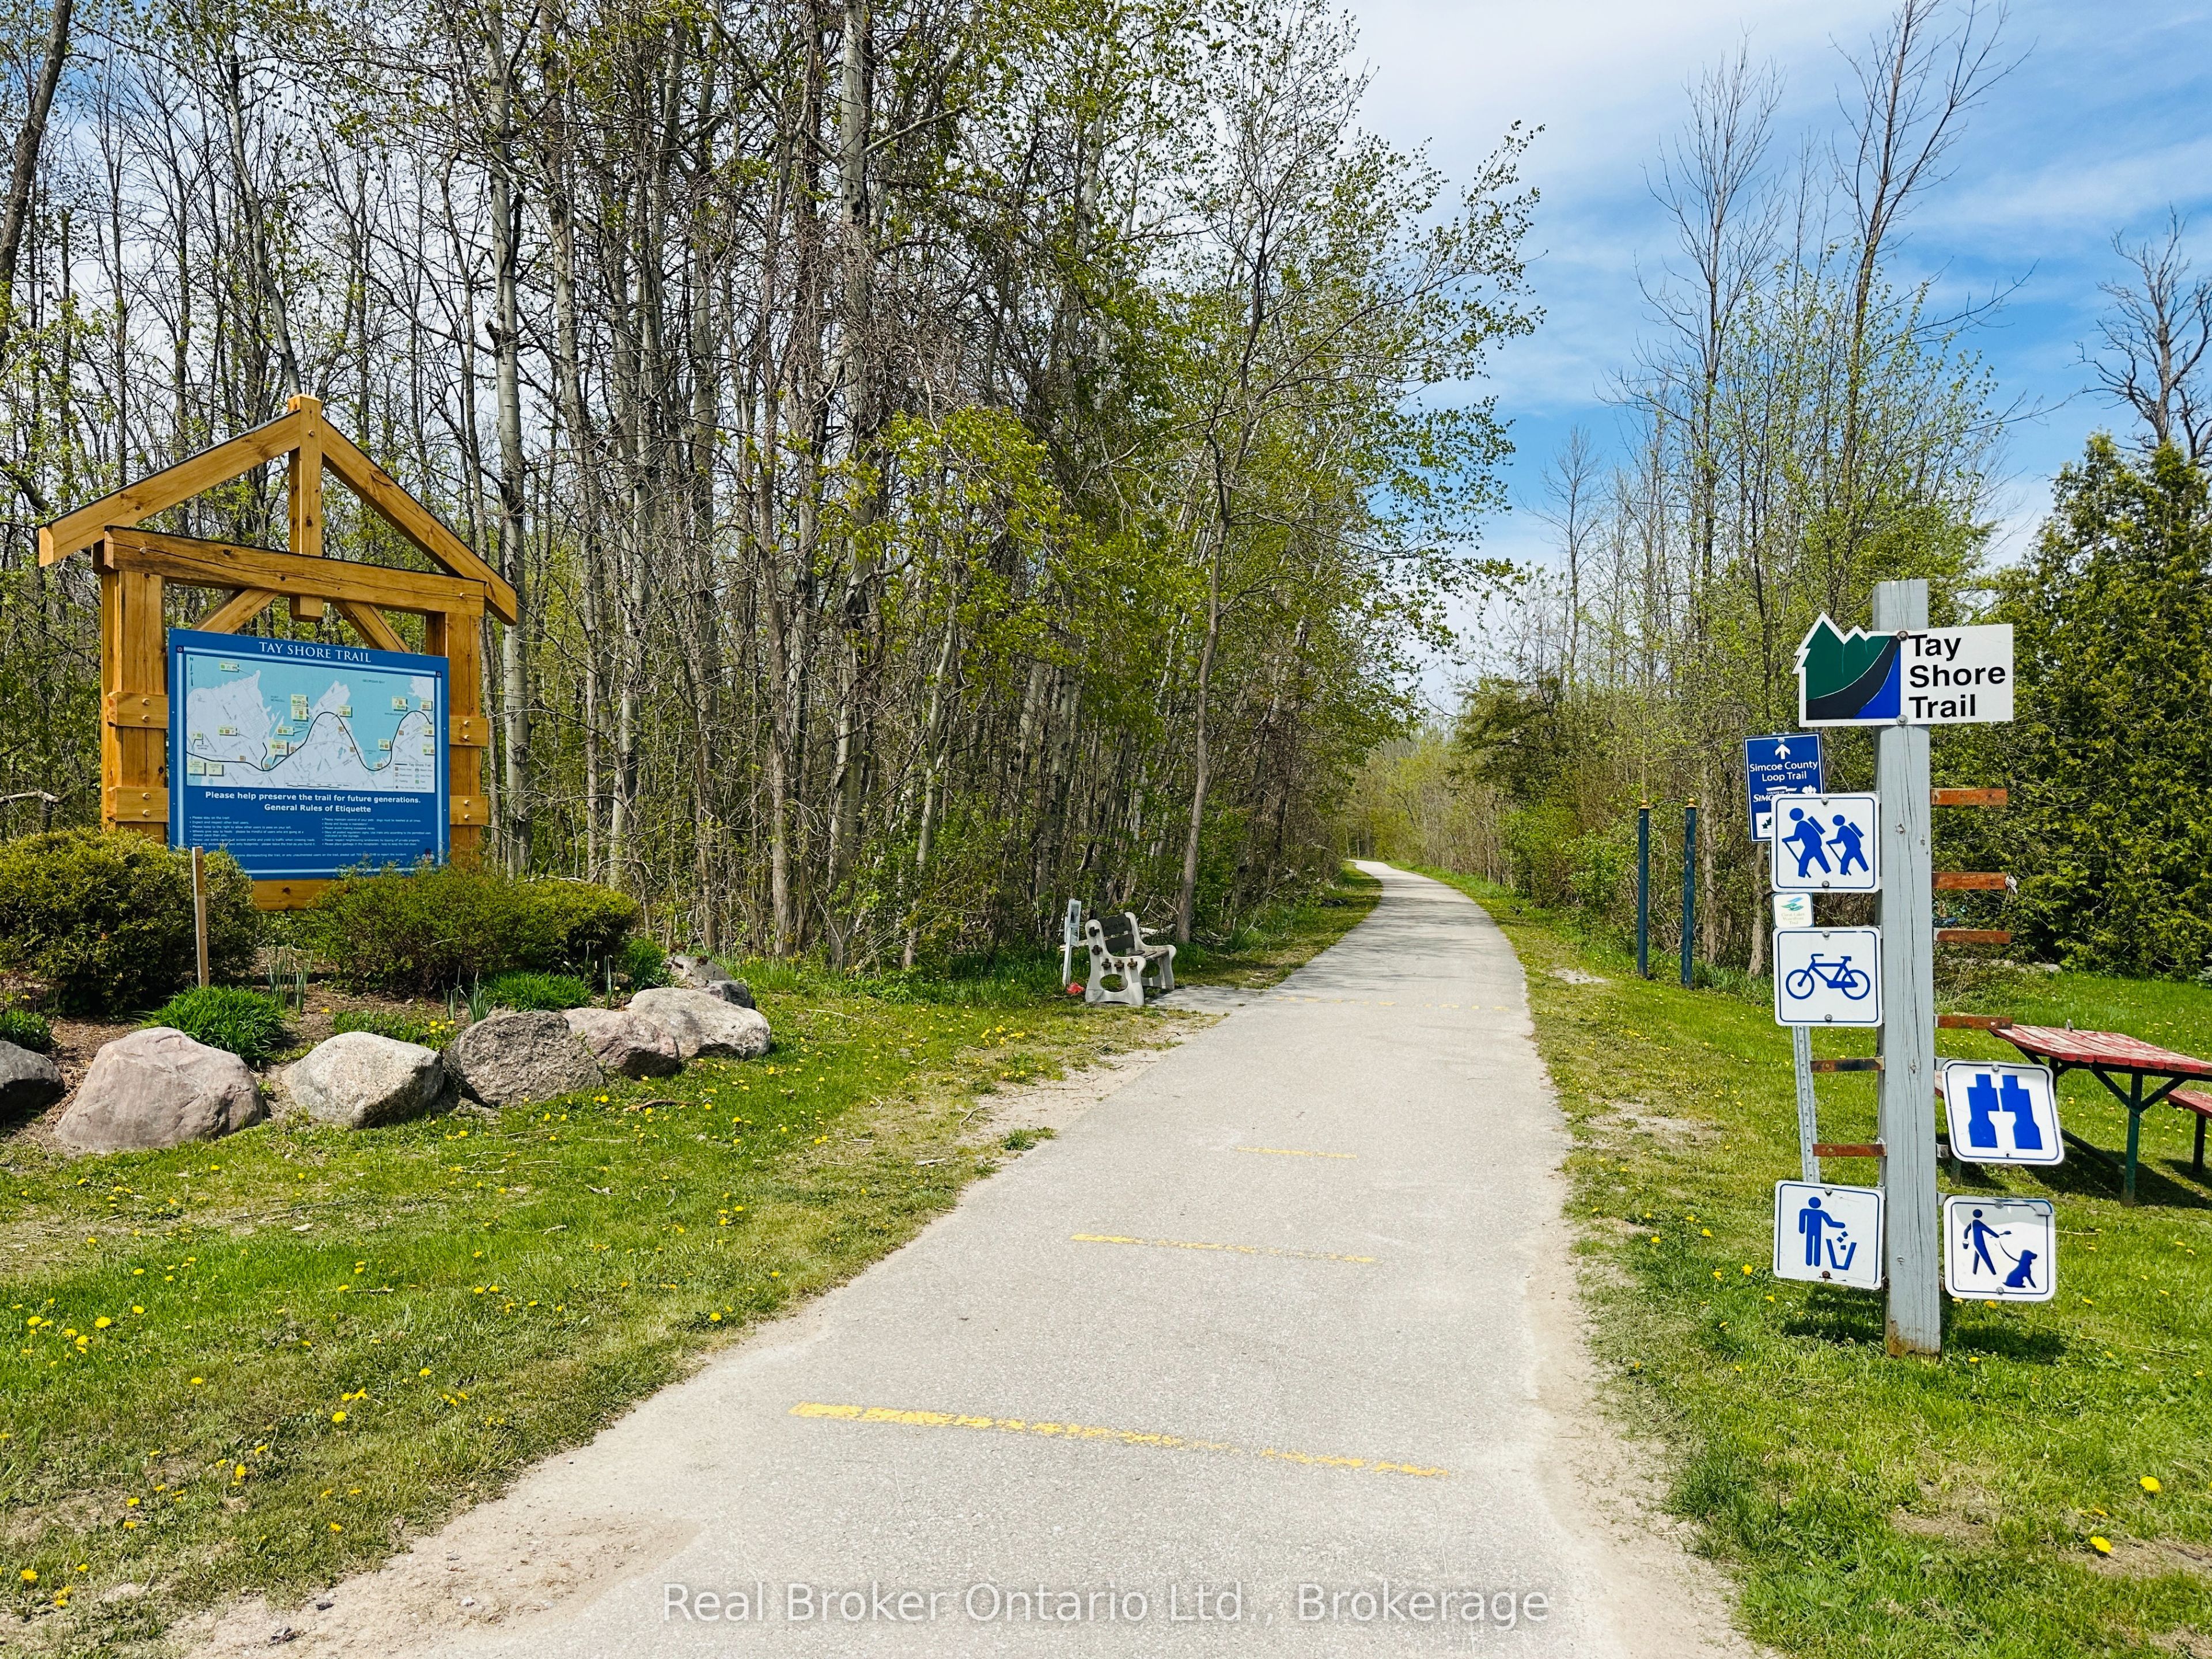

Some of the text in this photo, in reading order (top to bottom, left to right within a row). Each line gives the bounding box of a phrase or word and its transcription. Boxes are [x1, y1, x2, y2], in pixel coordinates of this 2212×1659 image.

[259, 642, 372, 662] TAY SHORE TRAIL
[1908, 634, 1961, 661] Tay
[1910, 664, 2006, 688] Shore
[1908, 694, 1976, 718] Trail
[1749, 760, 1818, 772] Simcoe County
[1762, 771, 1807, 782] Loop Trail
[237, 792, 256, 800] help
[335, 805, 372, 813] Etiquette
